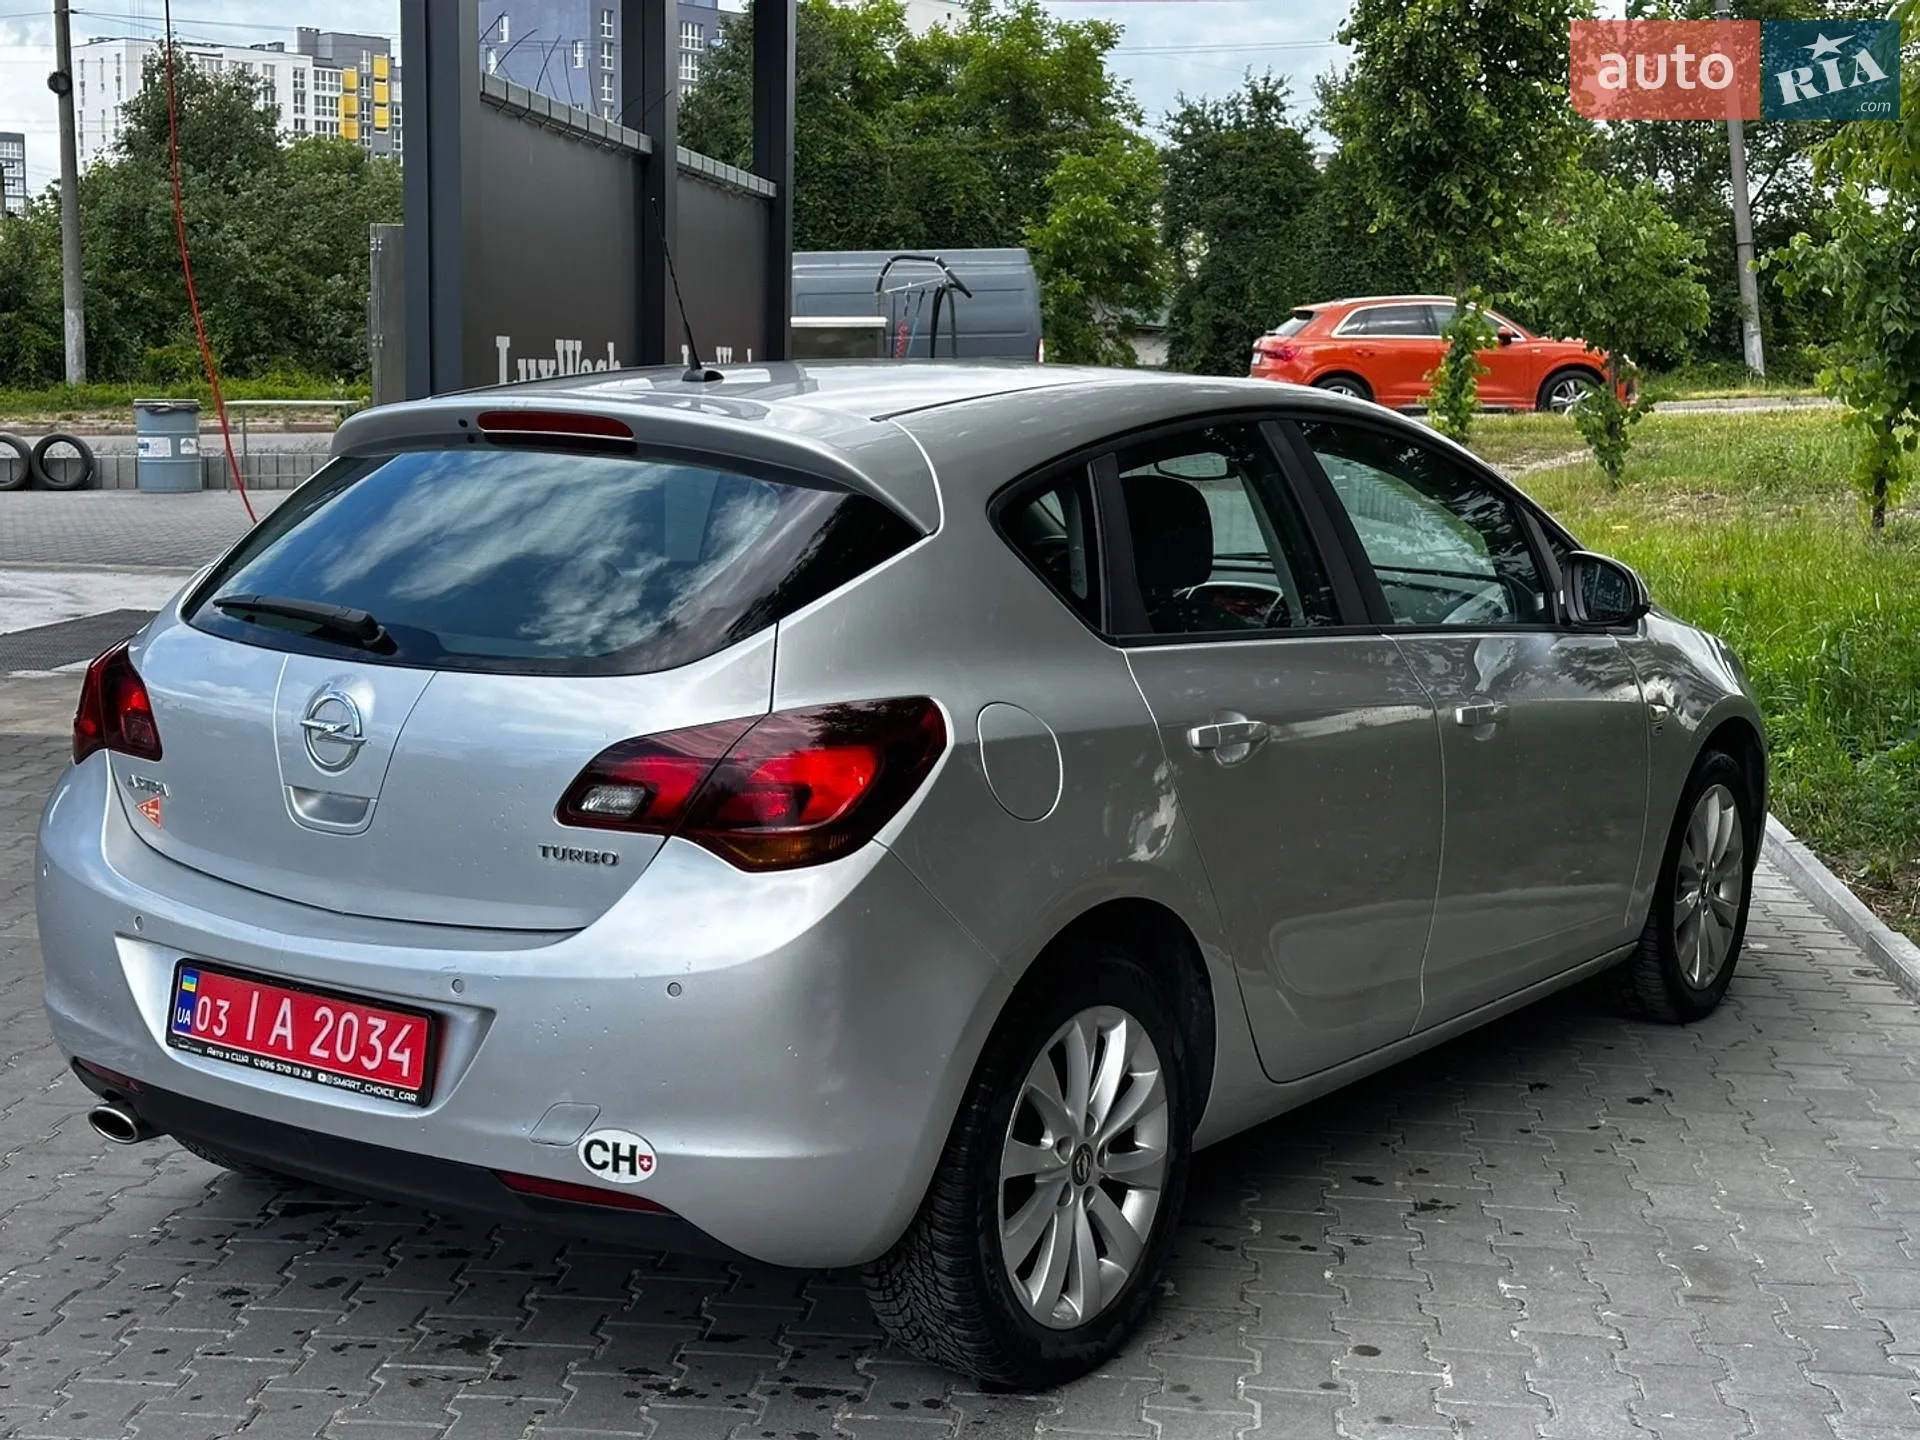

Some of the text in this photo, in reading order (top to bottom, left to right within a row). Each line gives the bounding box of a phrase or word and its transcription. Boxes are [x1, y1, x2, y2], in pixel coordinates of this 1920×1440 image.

[537, 843, 620, 867] TURBO
[177, 1006, 191, 1026] UA
[196, 991, 413, 1077] 03 IA 2034
[584, 1139, 638, 1176] CH
